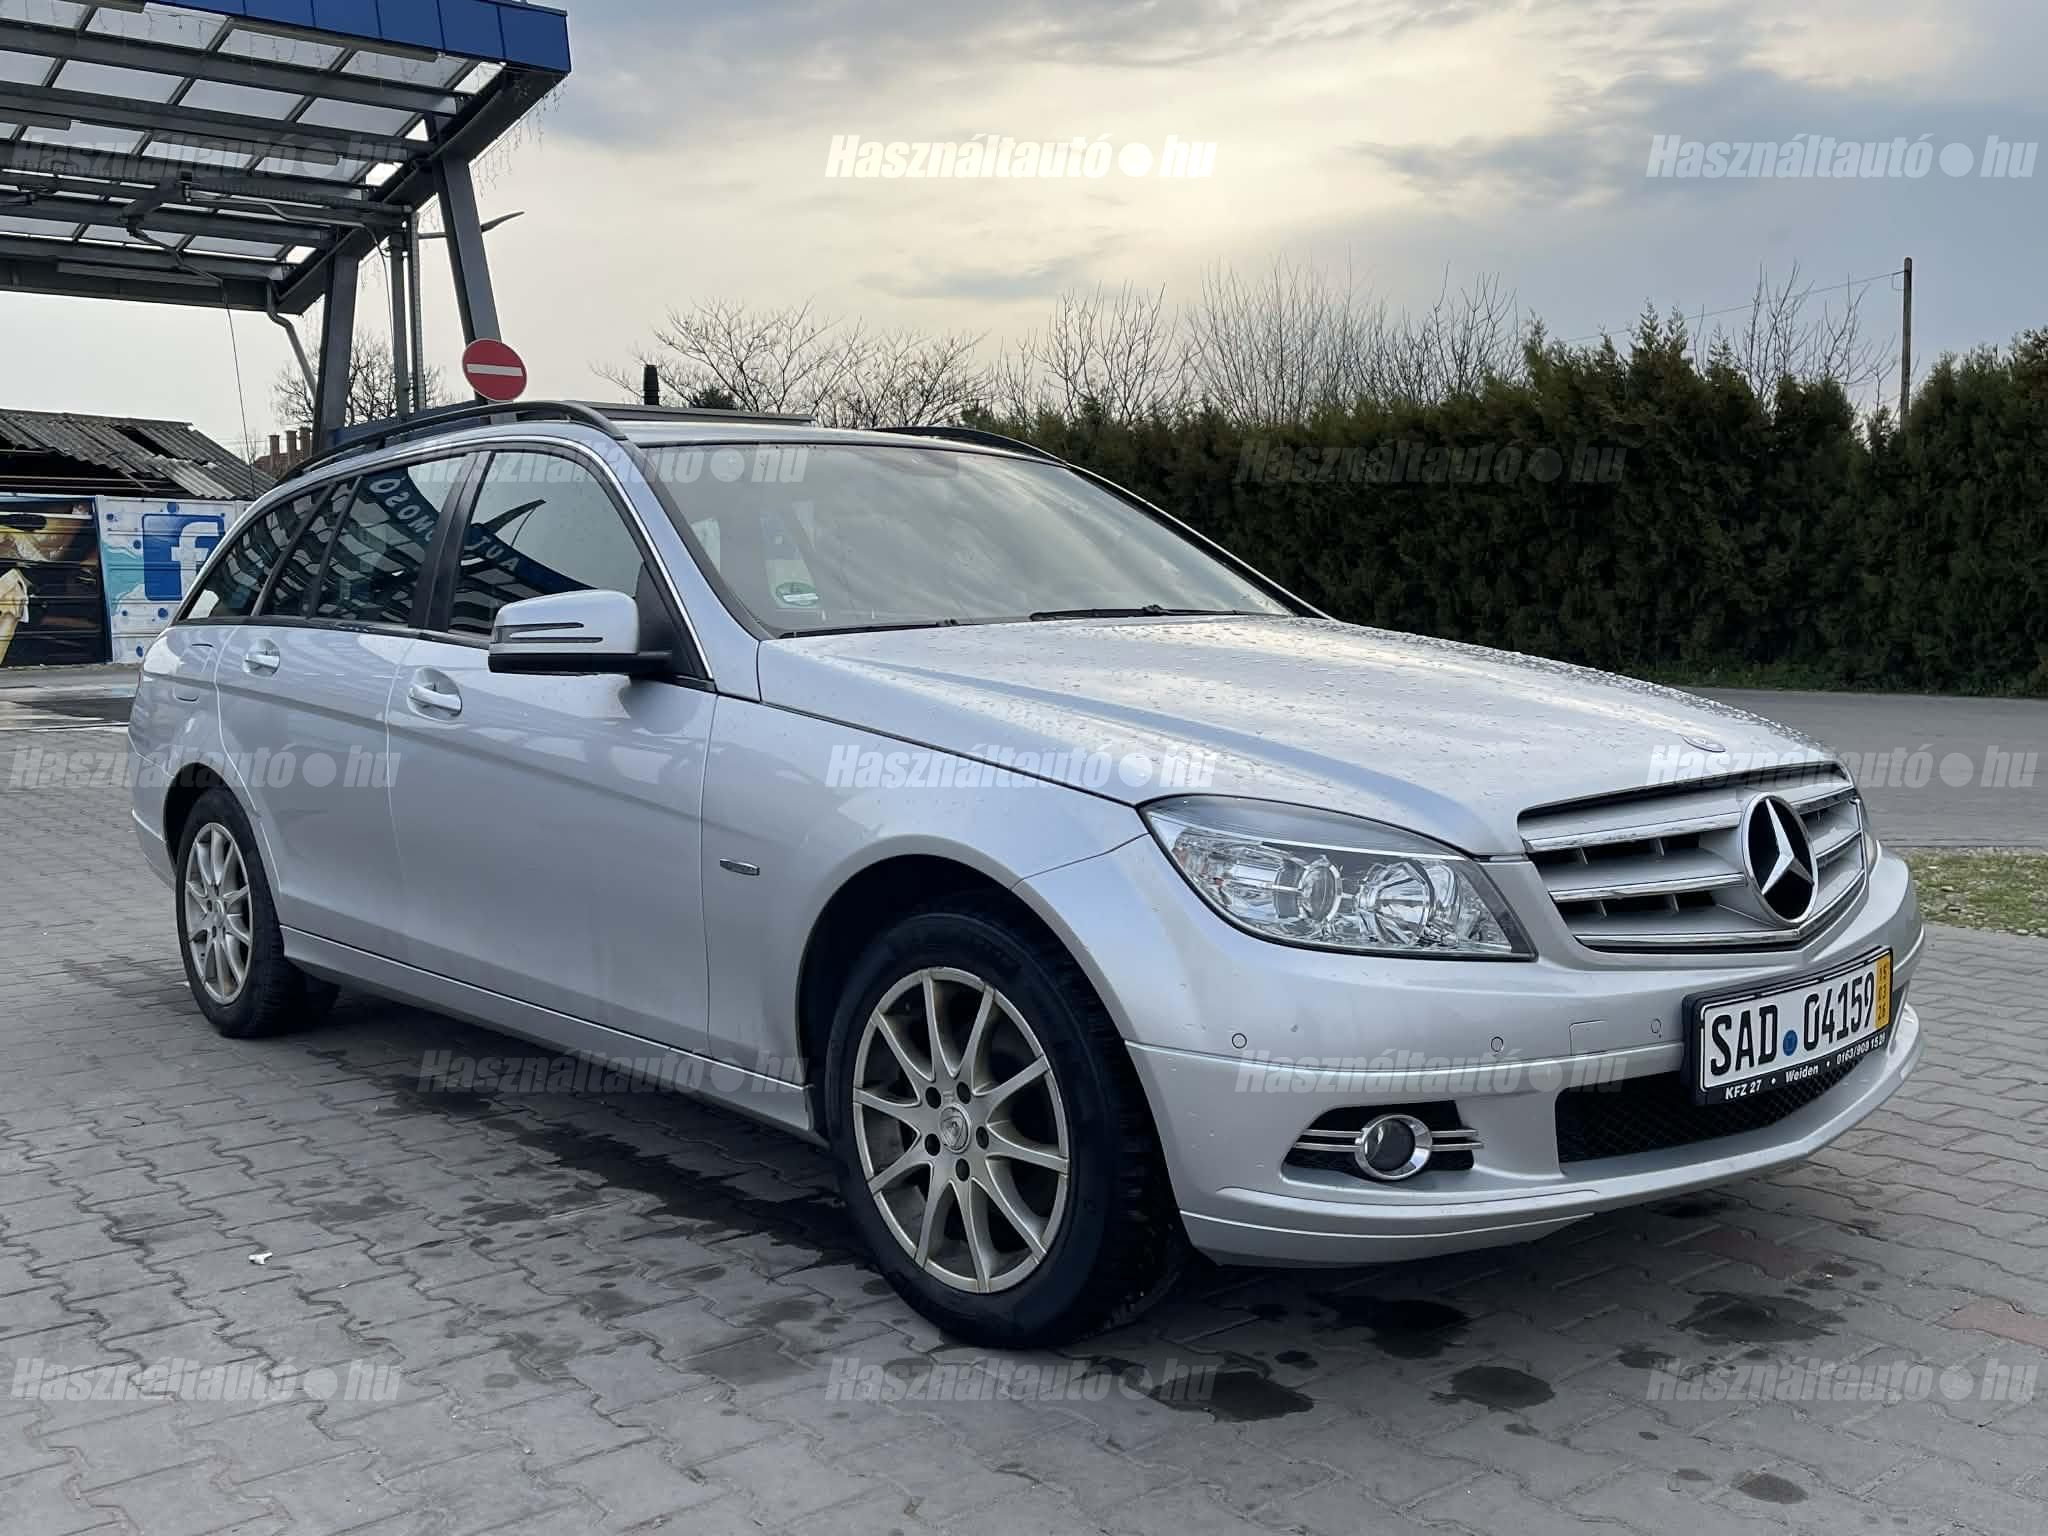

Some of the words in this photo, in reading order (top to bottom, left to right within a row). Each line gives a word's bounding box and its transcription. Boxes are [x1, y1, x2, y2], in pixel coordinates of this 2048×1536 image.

[1710, 1004, 1778, 1077] SAD
[1803, 971, 1875, 1052] 04159
[1725, 1083, 1748, 1100] KFZ
[1749, 1079, 1762, 1094] 27
[1785, 1064, 1819, 1083] Weiden
